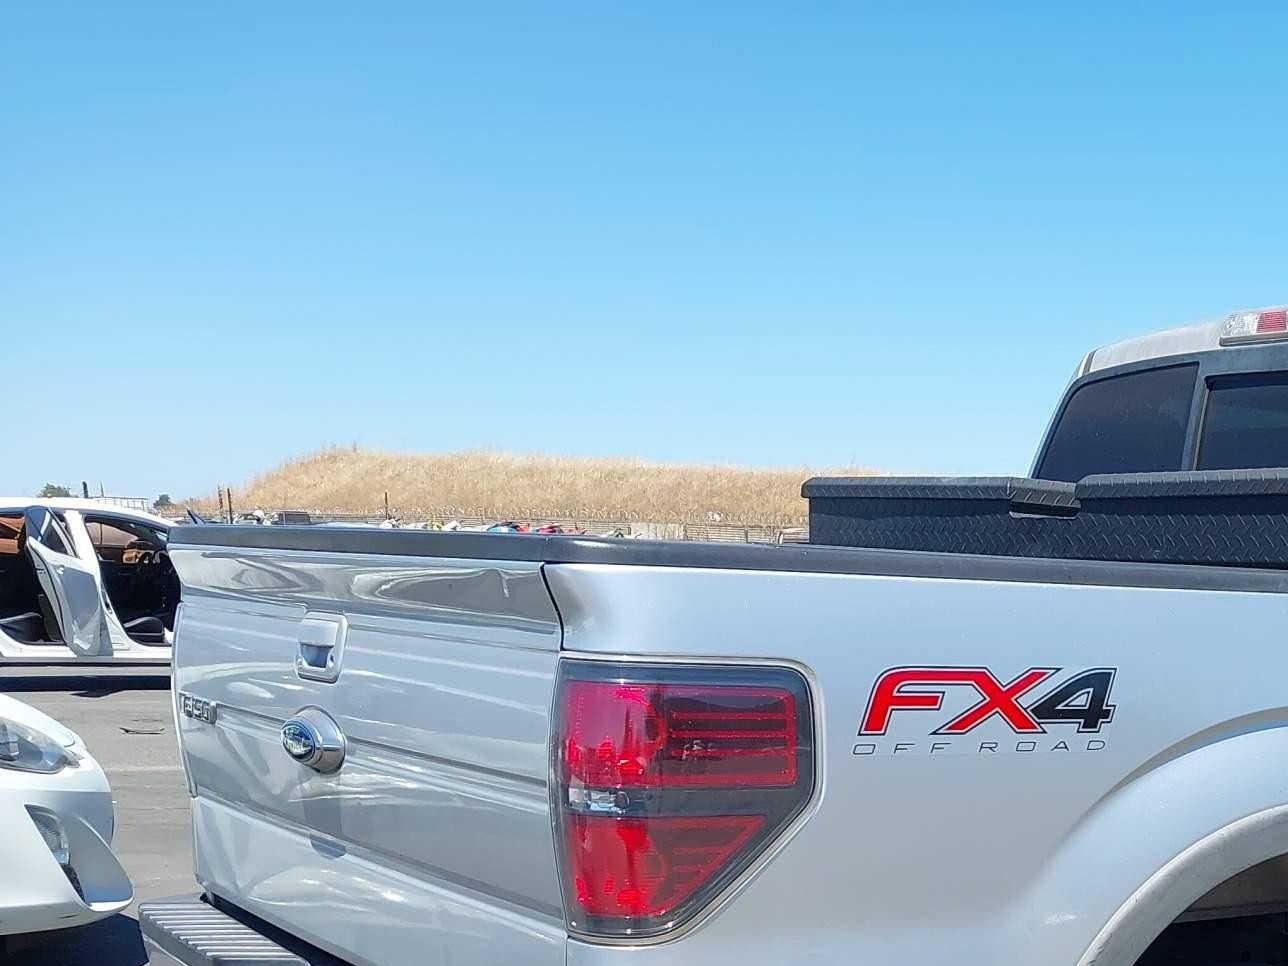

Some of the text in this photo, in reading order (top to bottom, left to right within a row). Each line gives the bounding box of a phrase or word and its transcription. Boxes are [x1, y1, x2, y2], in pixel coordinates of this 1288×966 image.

[857, 665, 1118, 737] FX4
[852, 739, 1107, 756] OFF ROAD
